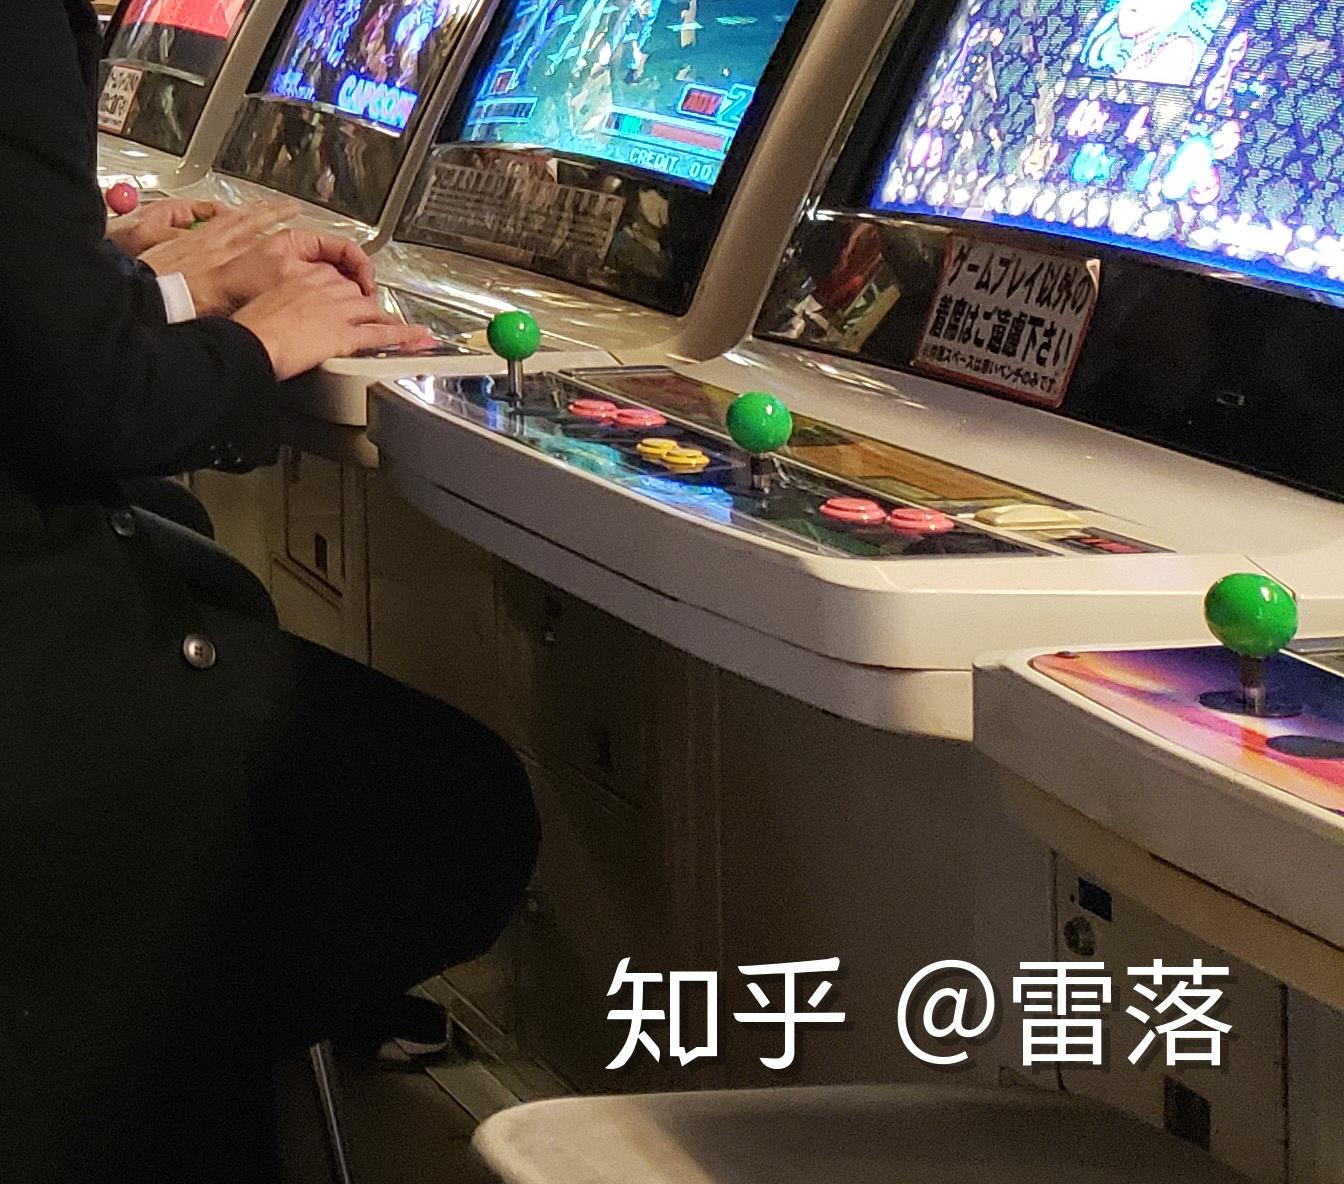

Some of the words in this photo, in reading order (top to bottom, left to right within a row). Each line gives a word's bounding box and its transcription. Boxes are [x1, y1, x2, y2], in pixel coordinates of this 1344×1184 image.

[338, 73, 418, 130] CAPCOM
[629, 146, 681, 173] CREDIT
[948, 245, 1092, 316] ゲームプレイ以外の
[928, 294, 1074, 367] 着席はご遠慮下さい
